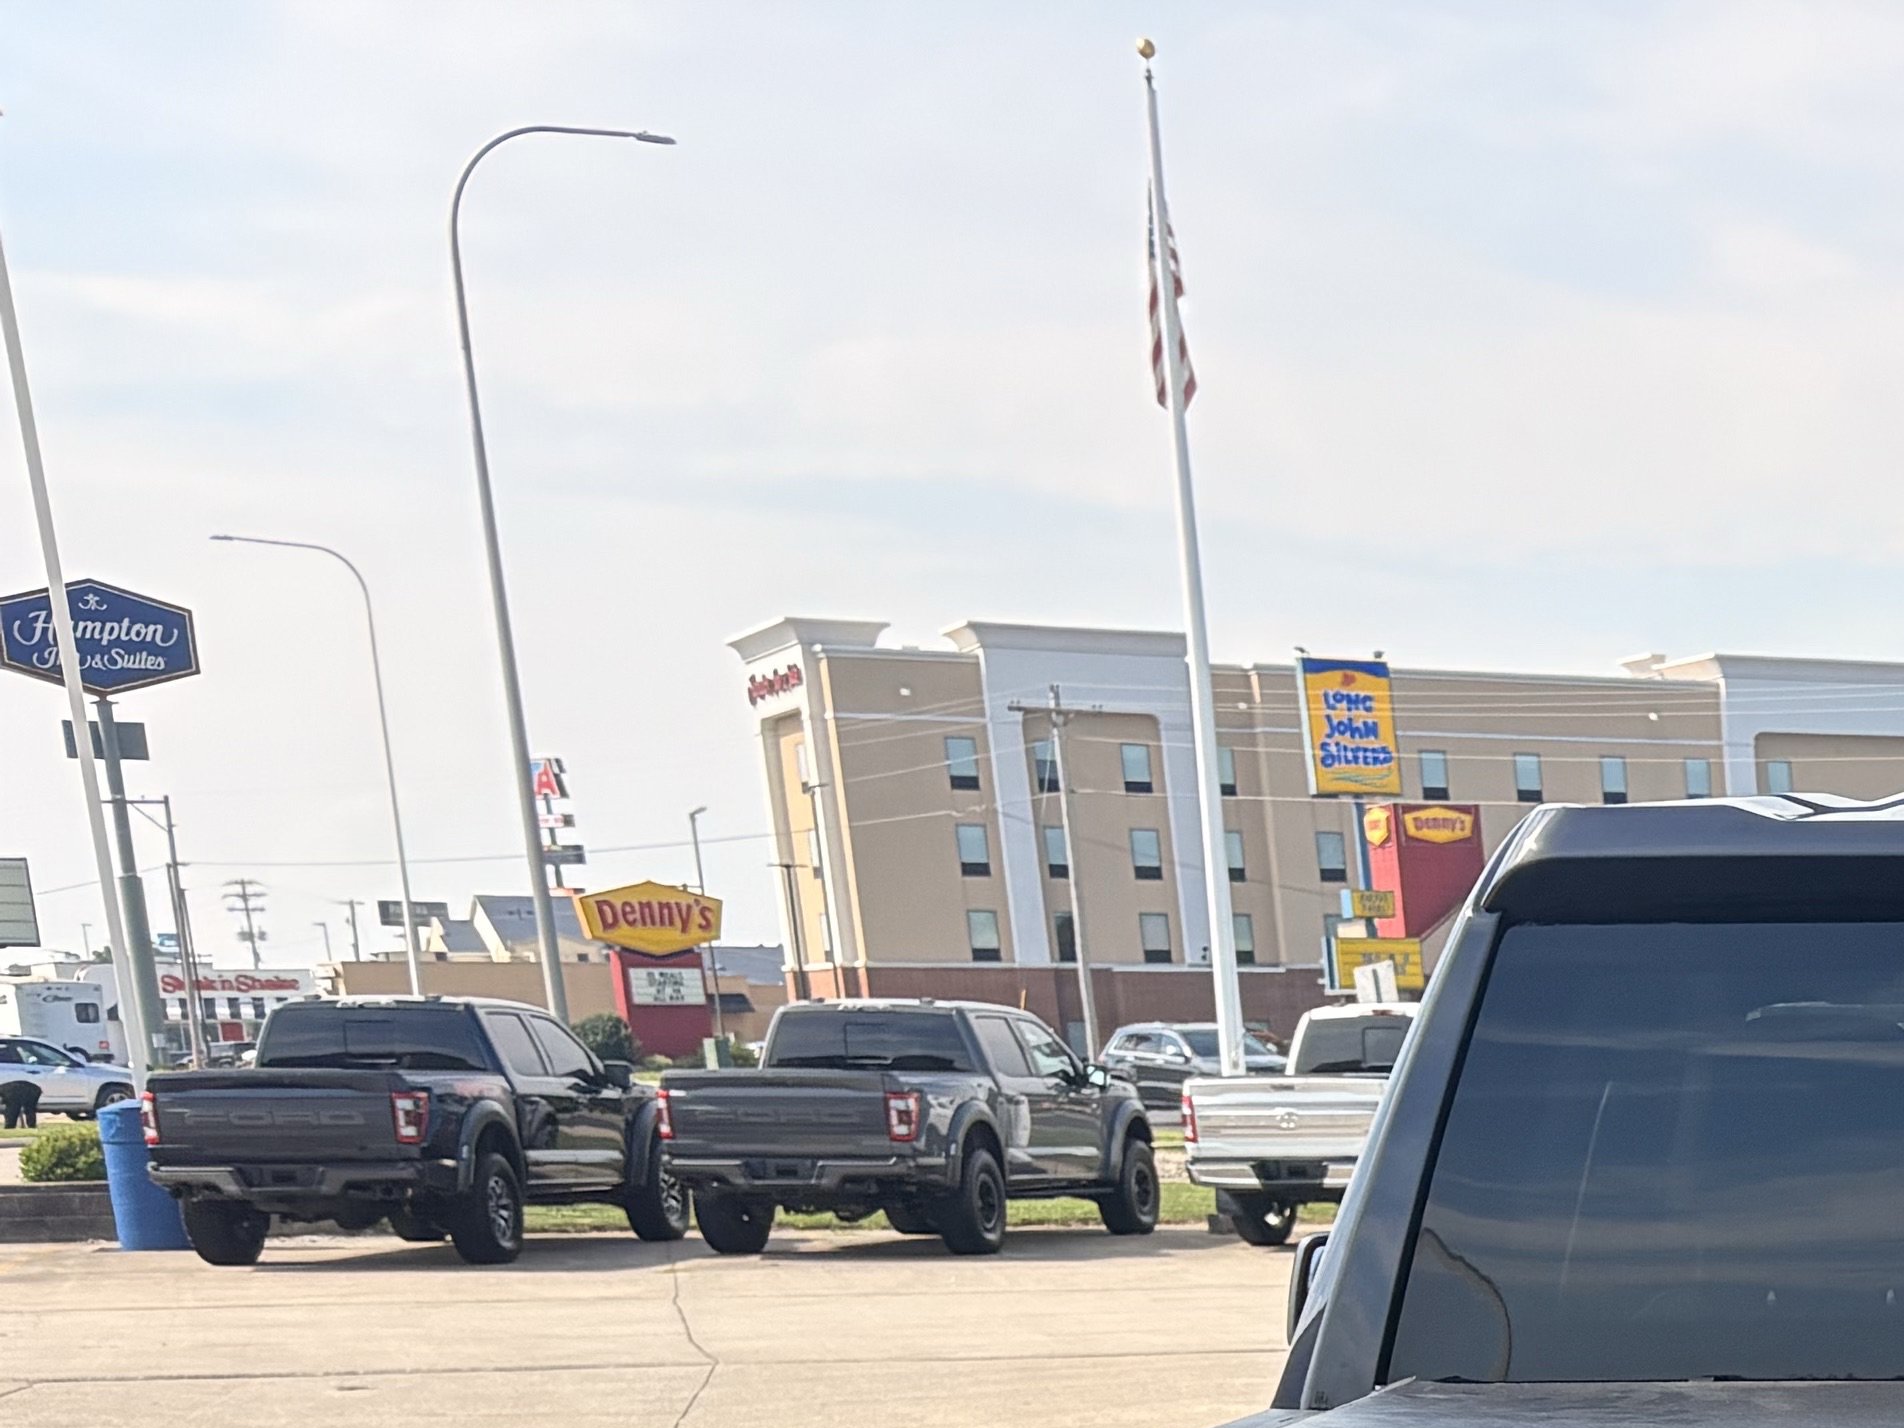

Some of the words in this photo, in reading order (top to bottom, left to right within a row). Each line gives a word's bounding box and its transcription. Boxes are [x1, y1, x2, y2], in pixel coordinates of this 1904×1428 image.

[13, 609, 179, 647] Hmpton
[104, 648, 166, 670] Suites
[1413, 816, 1466, 832] Denny's
[594, 898, 714, 934] Denny's
